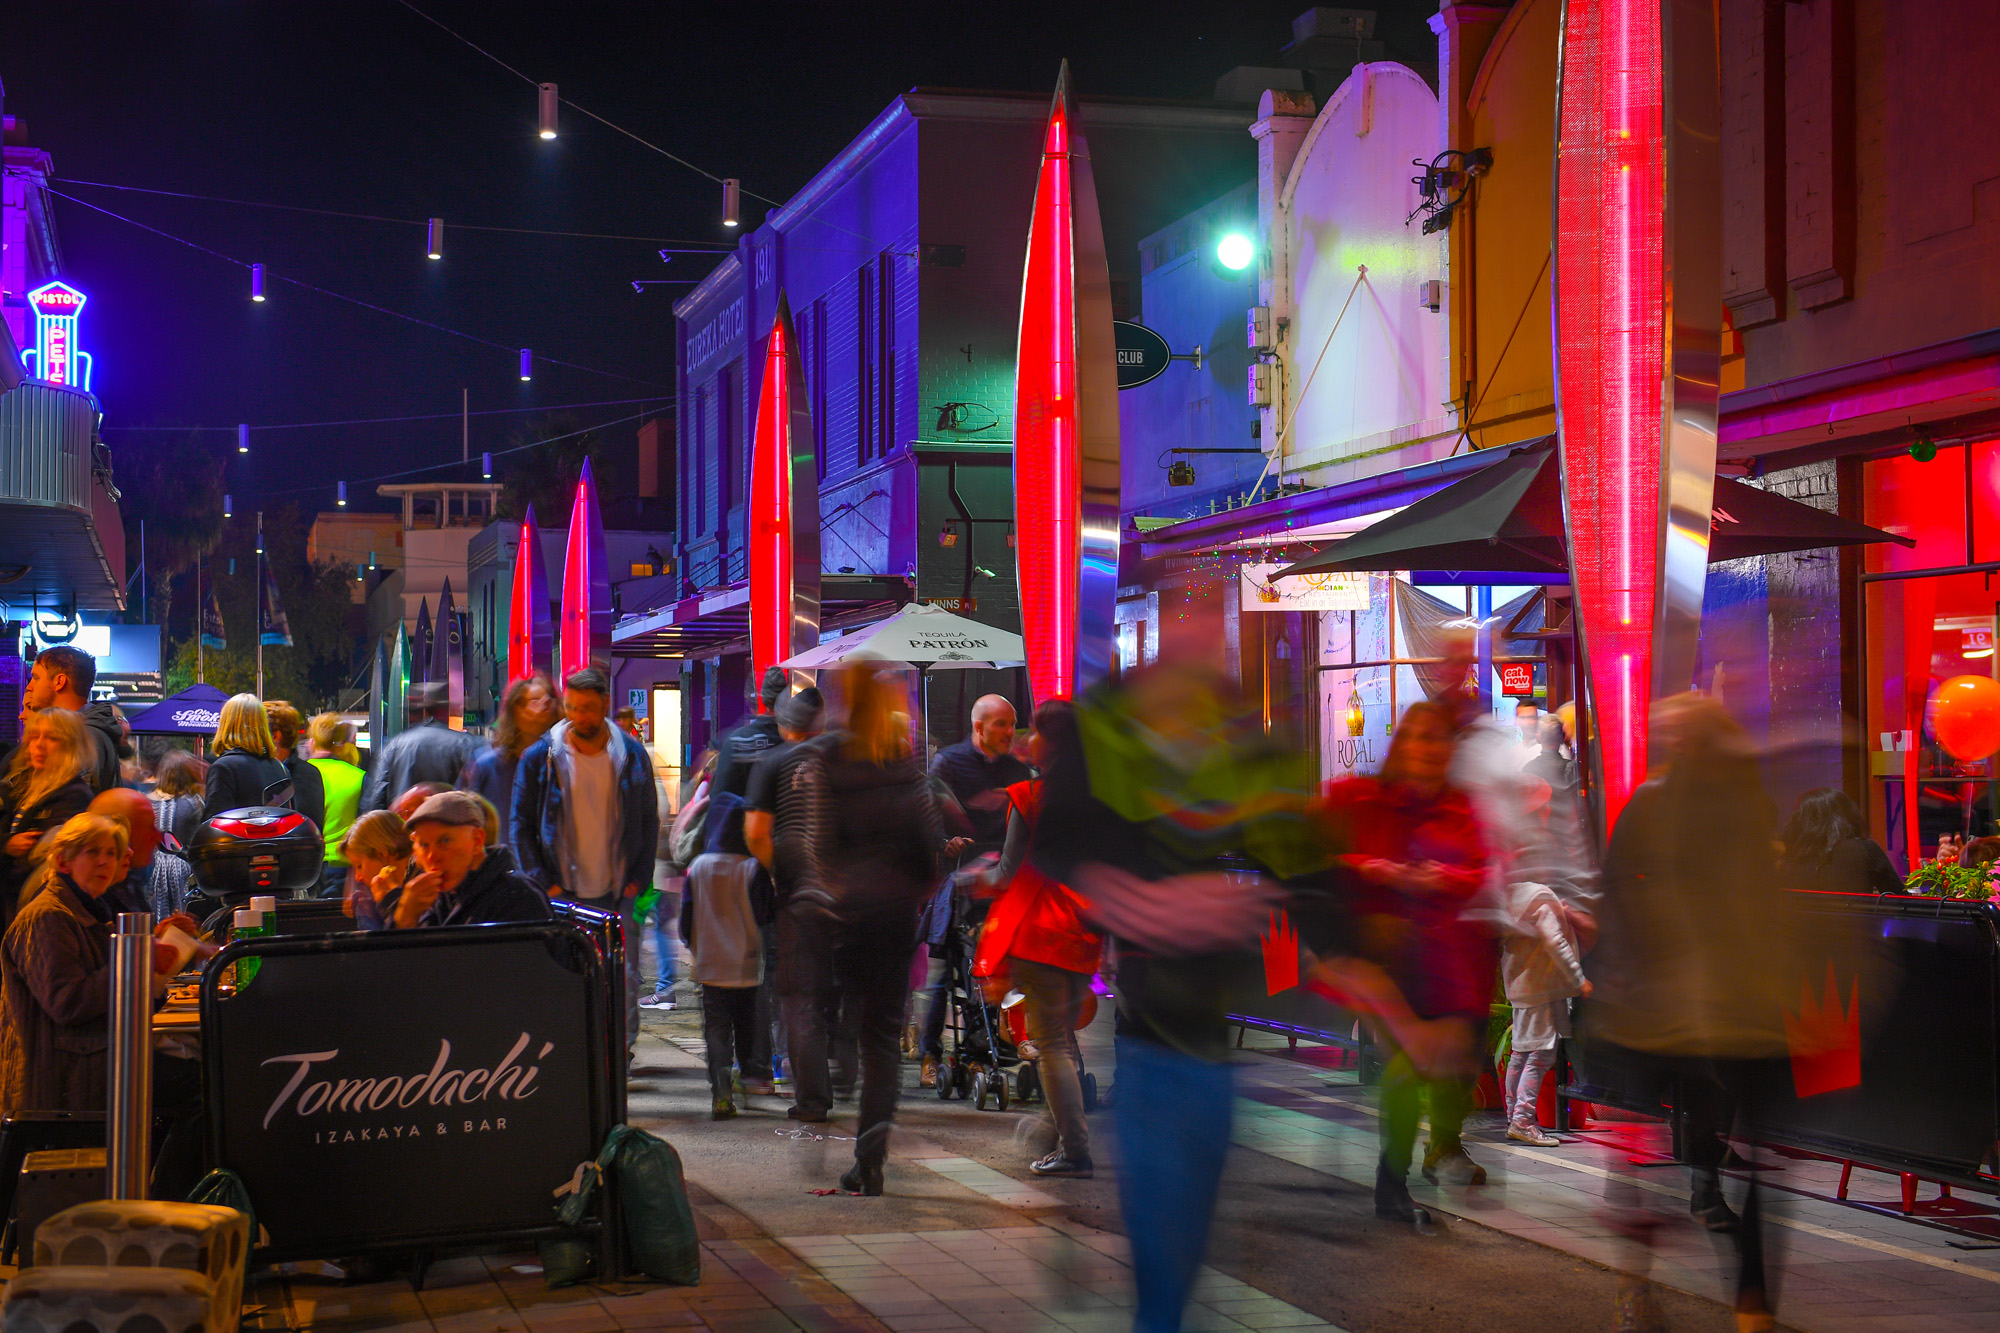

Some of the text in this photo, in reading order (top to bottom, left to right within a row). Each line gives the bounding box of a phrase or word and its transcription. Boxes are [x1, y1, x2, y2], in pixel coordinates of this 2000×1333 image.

[755, 243, 771, 290] 191
[34, 293, 79, 304] PISTOL
[686, 319, 718, 374] EUREKA
[1118, 351, 1143, 364] CLUB
[1300, 597, 1310, 608] Eat
[1312, 597, 1318, 607] in
[909, 638, 989, 649] PATRÓN
[1505, 667, 1523, 677] eat
[1505, 676, 1529, 686] now
[171, 709, 220, 722] Smok
[1338, 739, 1376, 768] ROYAL
[260, 1031, 554, 1130] Tomodachi
[315, 1117, 508, 1144] IZAKAYA & BAR
